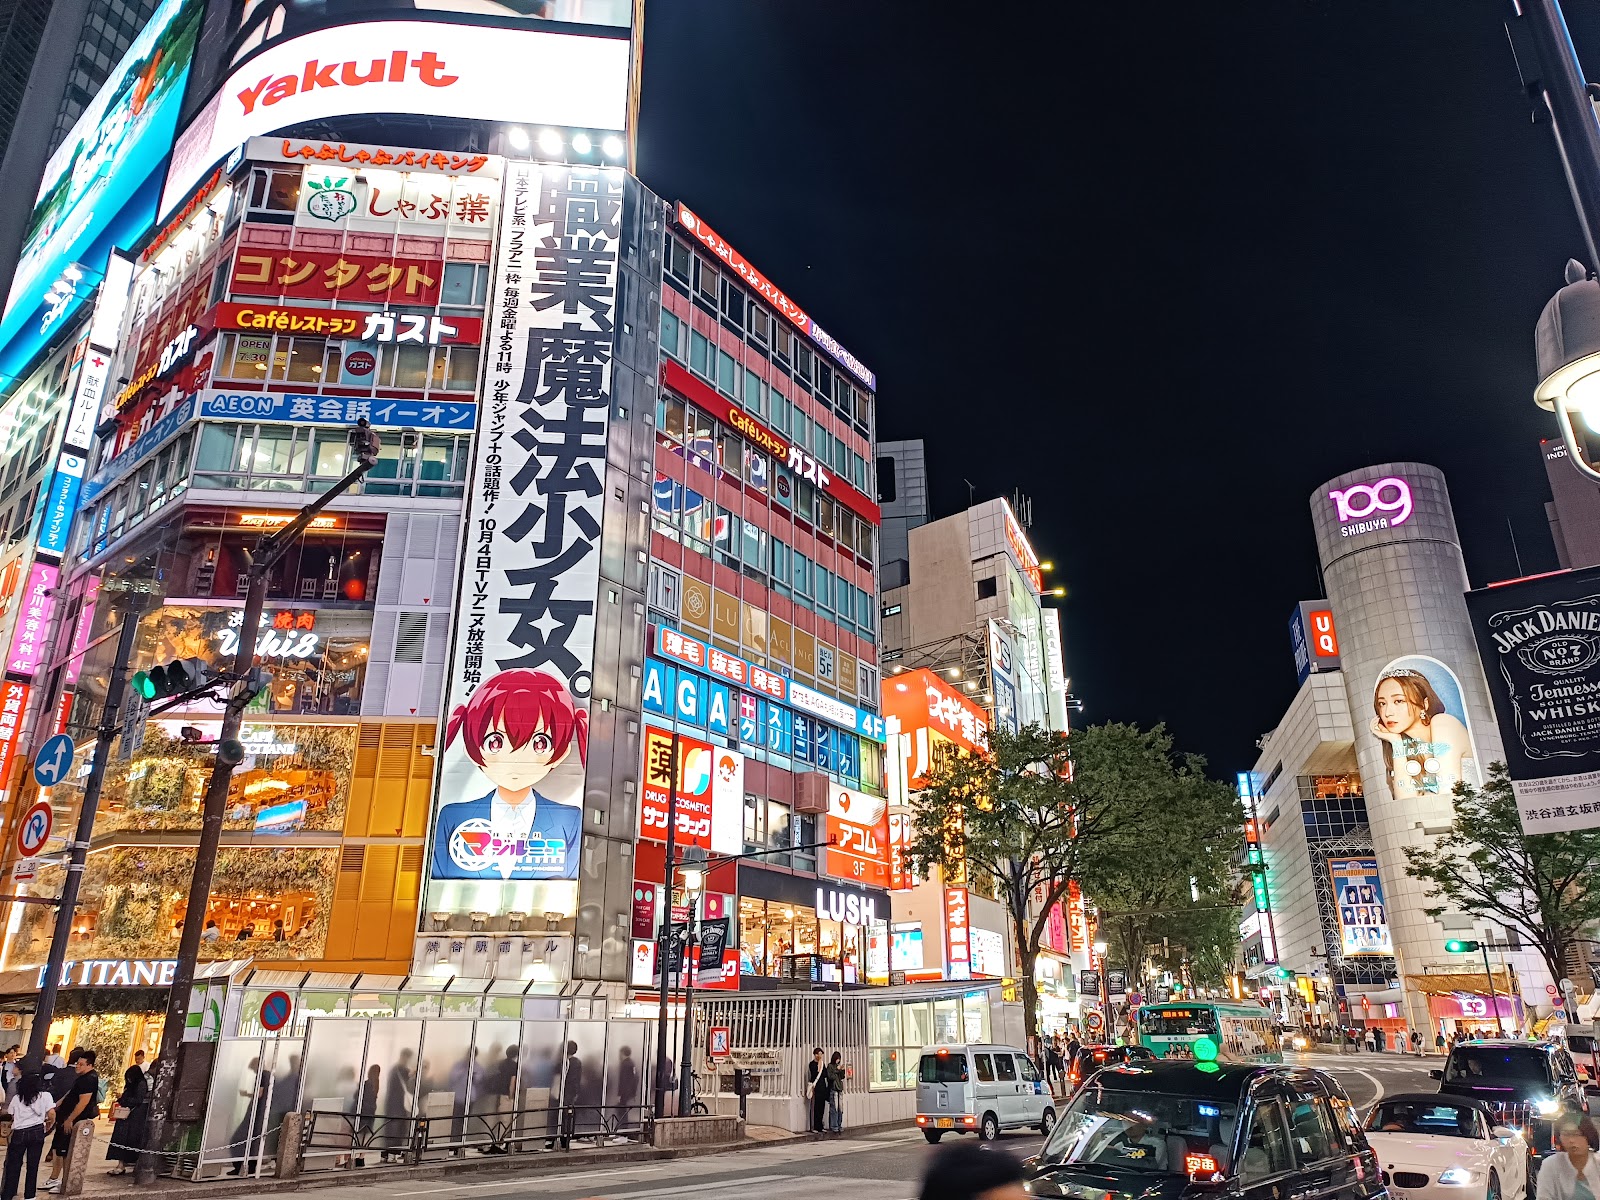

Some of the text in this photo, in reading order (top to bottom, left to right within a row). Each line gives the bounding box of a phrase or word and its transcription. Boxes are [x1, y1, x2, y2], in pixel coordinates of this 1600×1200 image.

[237, 51, 459, 116] Yakult
[281, 140, 488, 172] しゃぶしゃぶバイキング
[370, 187, 490, 226] しゃぶ葉
[236, 255, 435, 296] コンタクト
[695, 218, 808, 326] しゃぶしゃぶバイキング
[241, 340, 270, 350] OPEN
[361, 312, 459, 346] ガスト
[157, 324, 198, 377] ガスト
[349, 361, 372, 370] ガスト
[74, 375, 99, 435] 献血ルーム
[212, 396, 471, 425] AEON 英会話イーオン
[787, 446, 830, 489] ガスト
[1329, 477, 1414, 527] 109
[1341, 519, 1388, 537] SHIBUYA
[18, 584, 46, 656] 品川美容外科
[273, 610, 315, 631] 焼肉
[1315, 616, 1335, 653] UQ
[1491, 618, 1543, 654] JACK
[12, 659, 32, 671] 4F
[1549, 657, 1580, 666] BRAND
[1569, 645, 1581, 656] 7
[665, 631, 883, 738] 薄毛 抜毛 発毛 4F
[819, 660, 833, 681] 5F
[1553, 676, 1586, 686] QUALITY
[643, 668, 728, 728] AGA
[1529, 701, 1600, 721] WHISK
[1540, 698, 1571, 708] SOUR
[926, 685, 989, 754] スギ薬局
[1531, 730, 1553, 738] JACK
[1555, 726, 1587, 735] DANIEL
[1543, 722, 1572, 730] DISTILLED
[1573, 719, 1586, 727] AND
[645, 790, 711, 815] DRUG COSMETIC
[839, 823, 877, 855] アコム
[853, 861, 866, 877] 3F
[816, 888, 875, 925] LUSH
[426, 940, 558, 954] 渋谷駅前ビル
